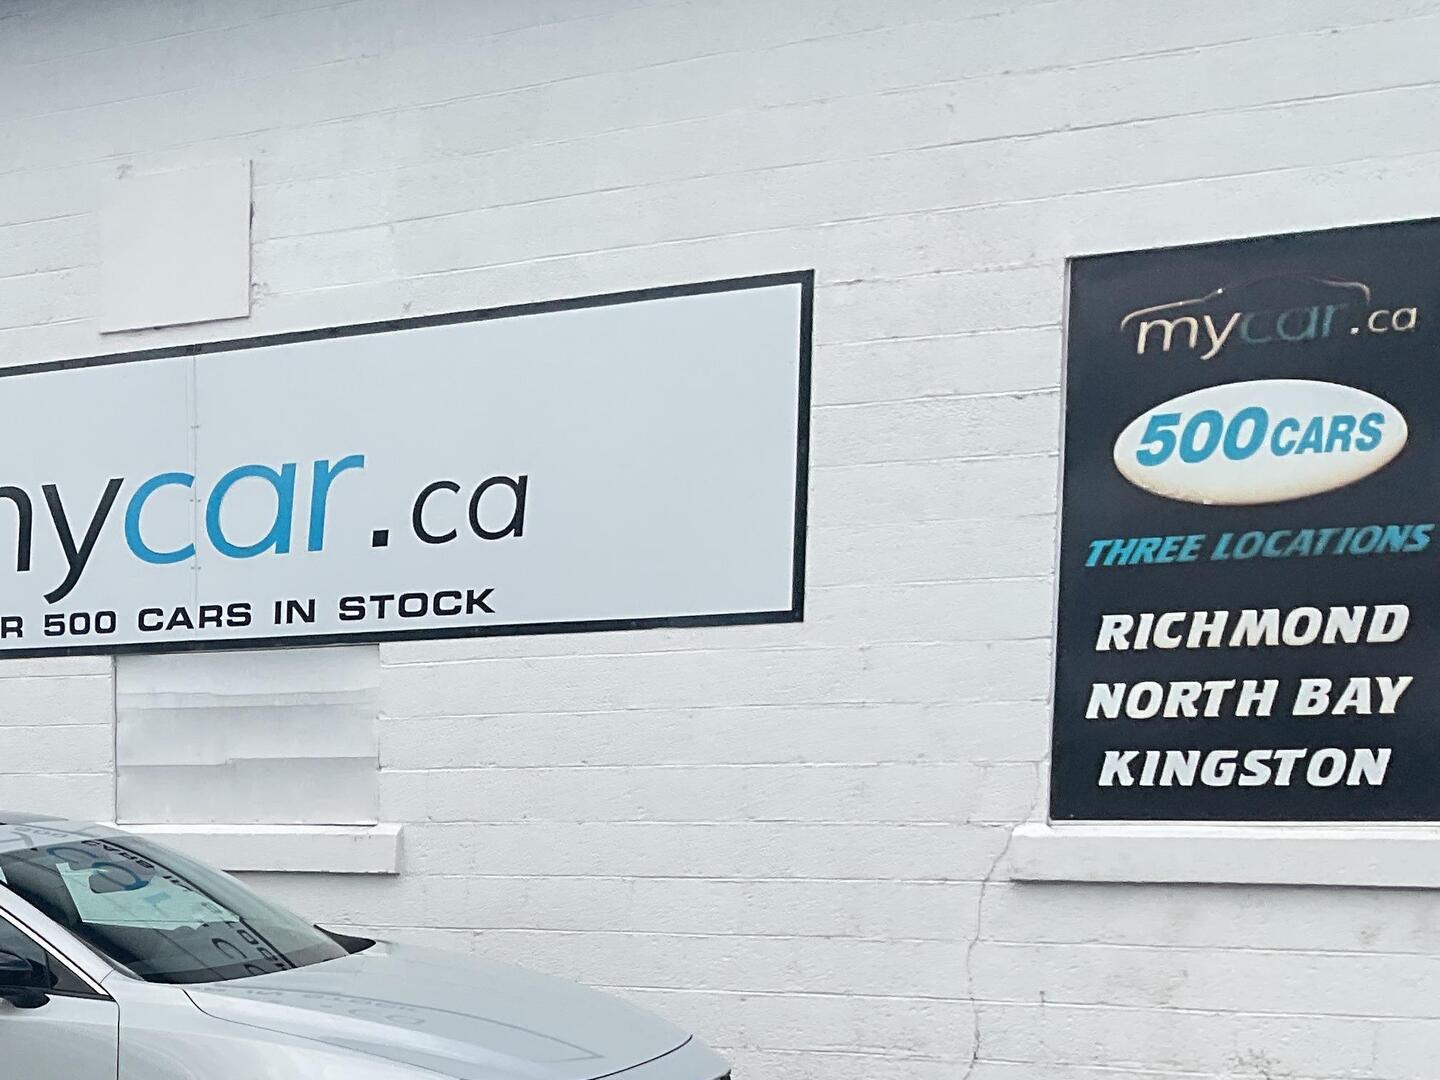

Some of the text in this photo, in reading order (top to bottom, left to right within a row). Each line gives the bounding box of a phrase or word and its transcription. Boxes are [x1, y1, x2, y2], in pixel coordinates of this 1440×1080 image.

[1135, 406, 1386, 467] 500 CARS
[1085, 523, 1435, 567] THREE LOCATIONS
[43, 609, 117, 636] 500
[137, 603, 252, 632] CARS
[273, 599, 317, 624] IN
[338, 588, 495, 622] STOCK
[1096, 604, 1409, 650] RICHMOND
[1085, 676, 1414, 720] NORTH BAY
[1097, 747, 1392, 787] KINGSTON
